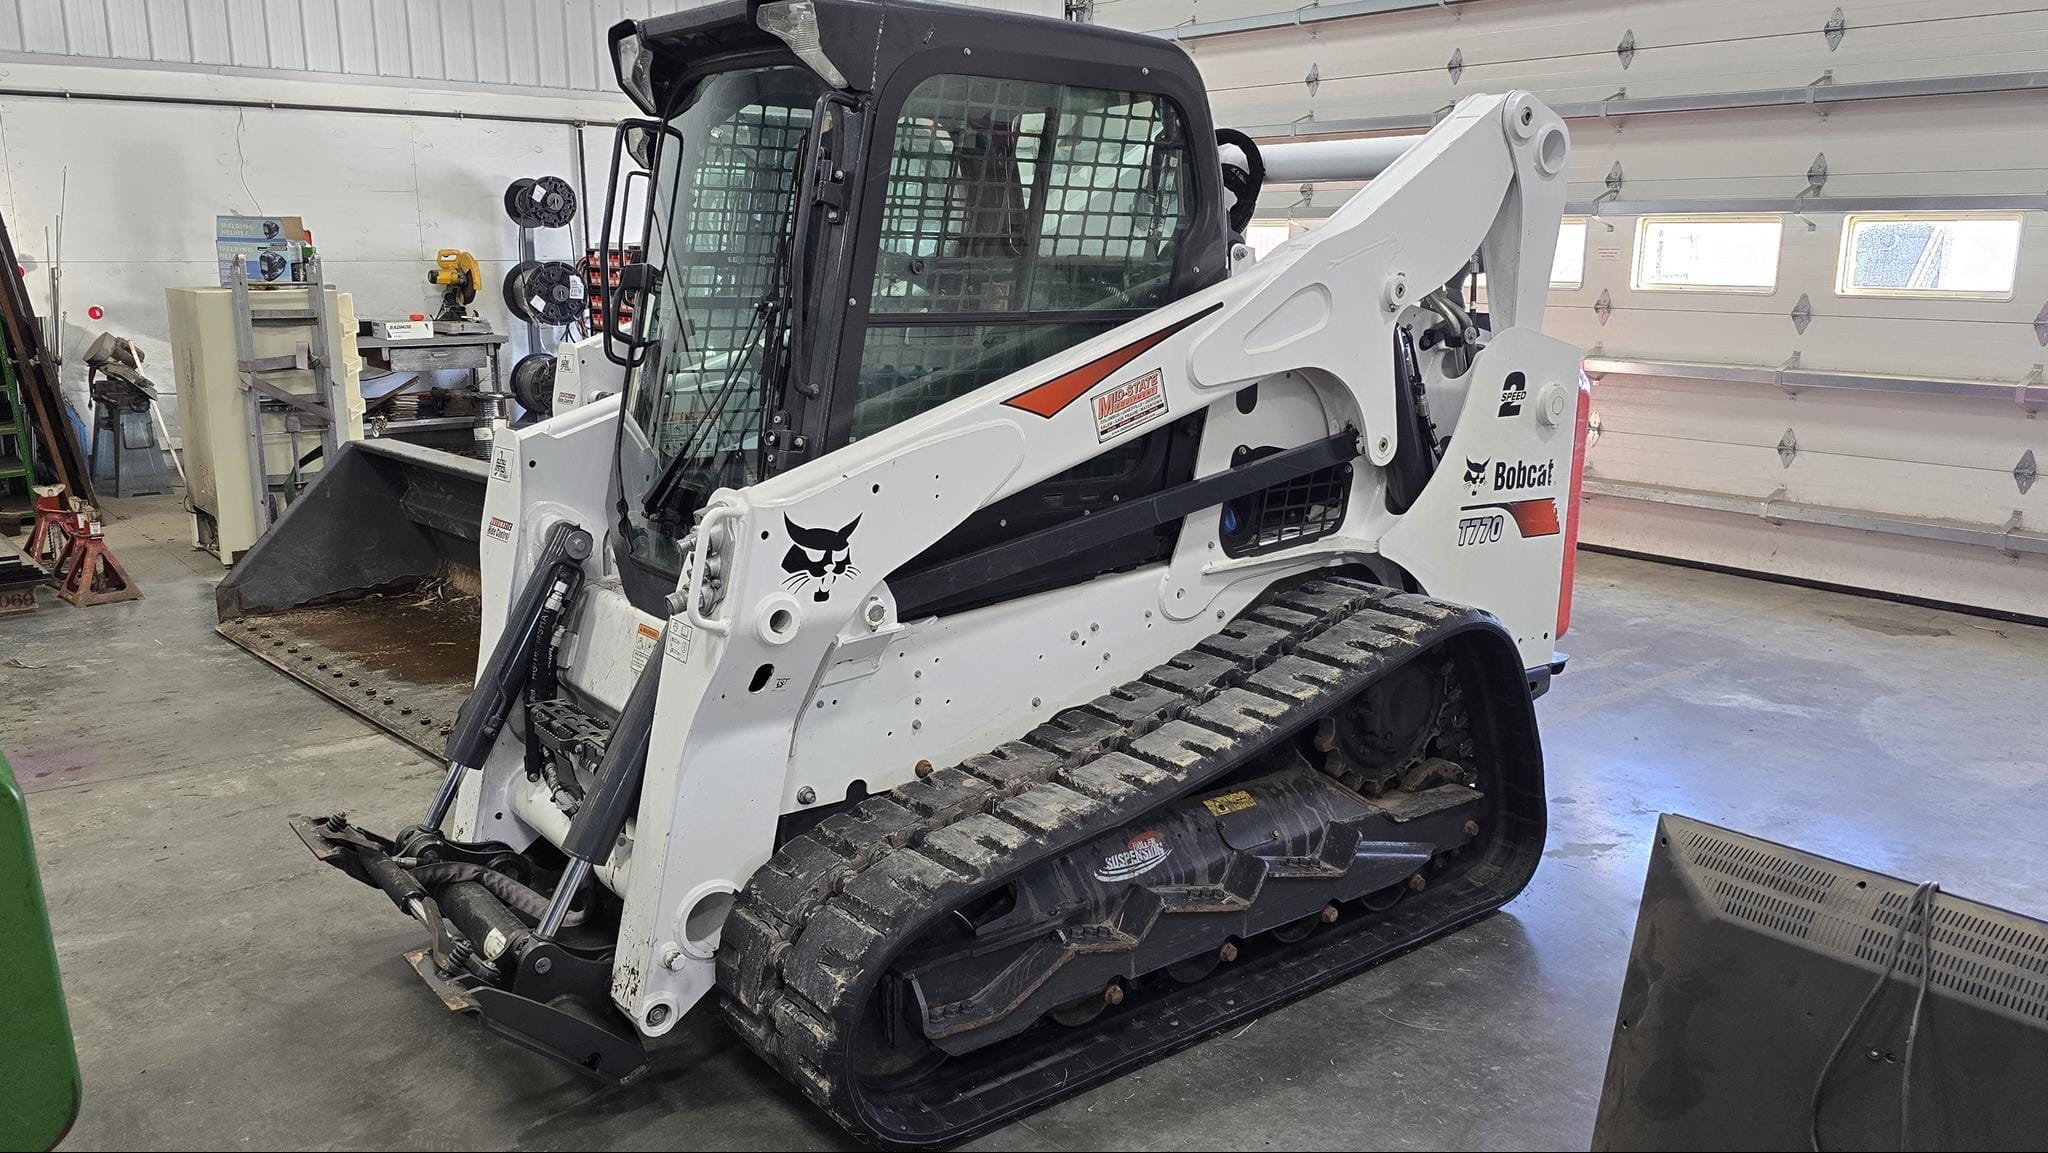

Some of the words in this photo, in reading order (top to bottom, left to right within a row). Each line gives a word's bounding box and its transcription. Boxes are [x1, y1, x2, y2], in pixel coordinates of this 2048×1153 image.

[1497, 371, 1526, 417] 2
[1501, 391, 1527, 402] SPEED
[1494, 458, 1553, 490] Bobcat
[1458, 515, 1504, 546] T770
[1105, 841, 1165, 870] SUSPENSION
